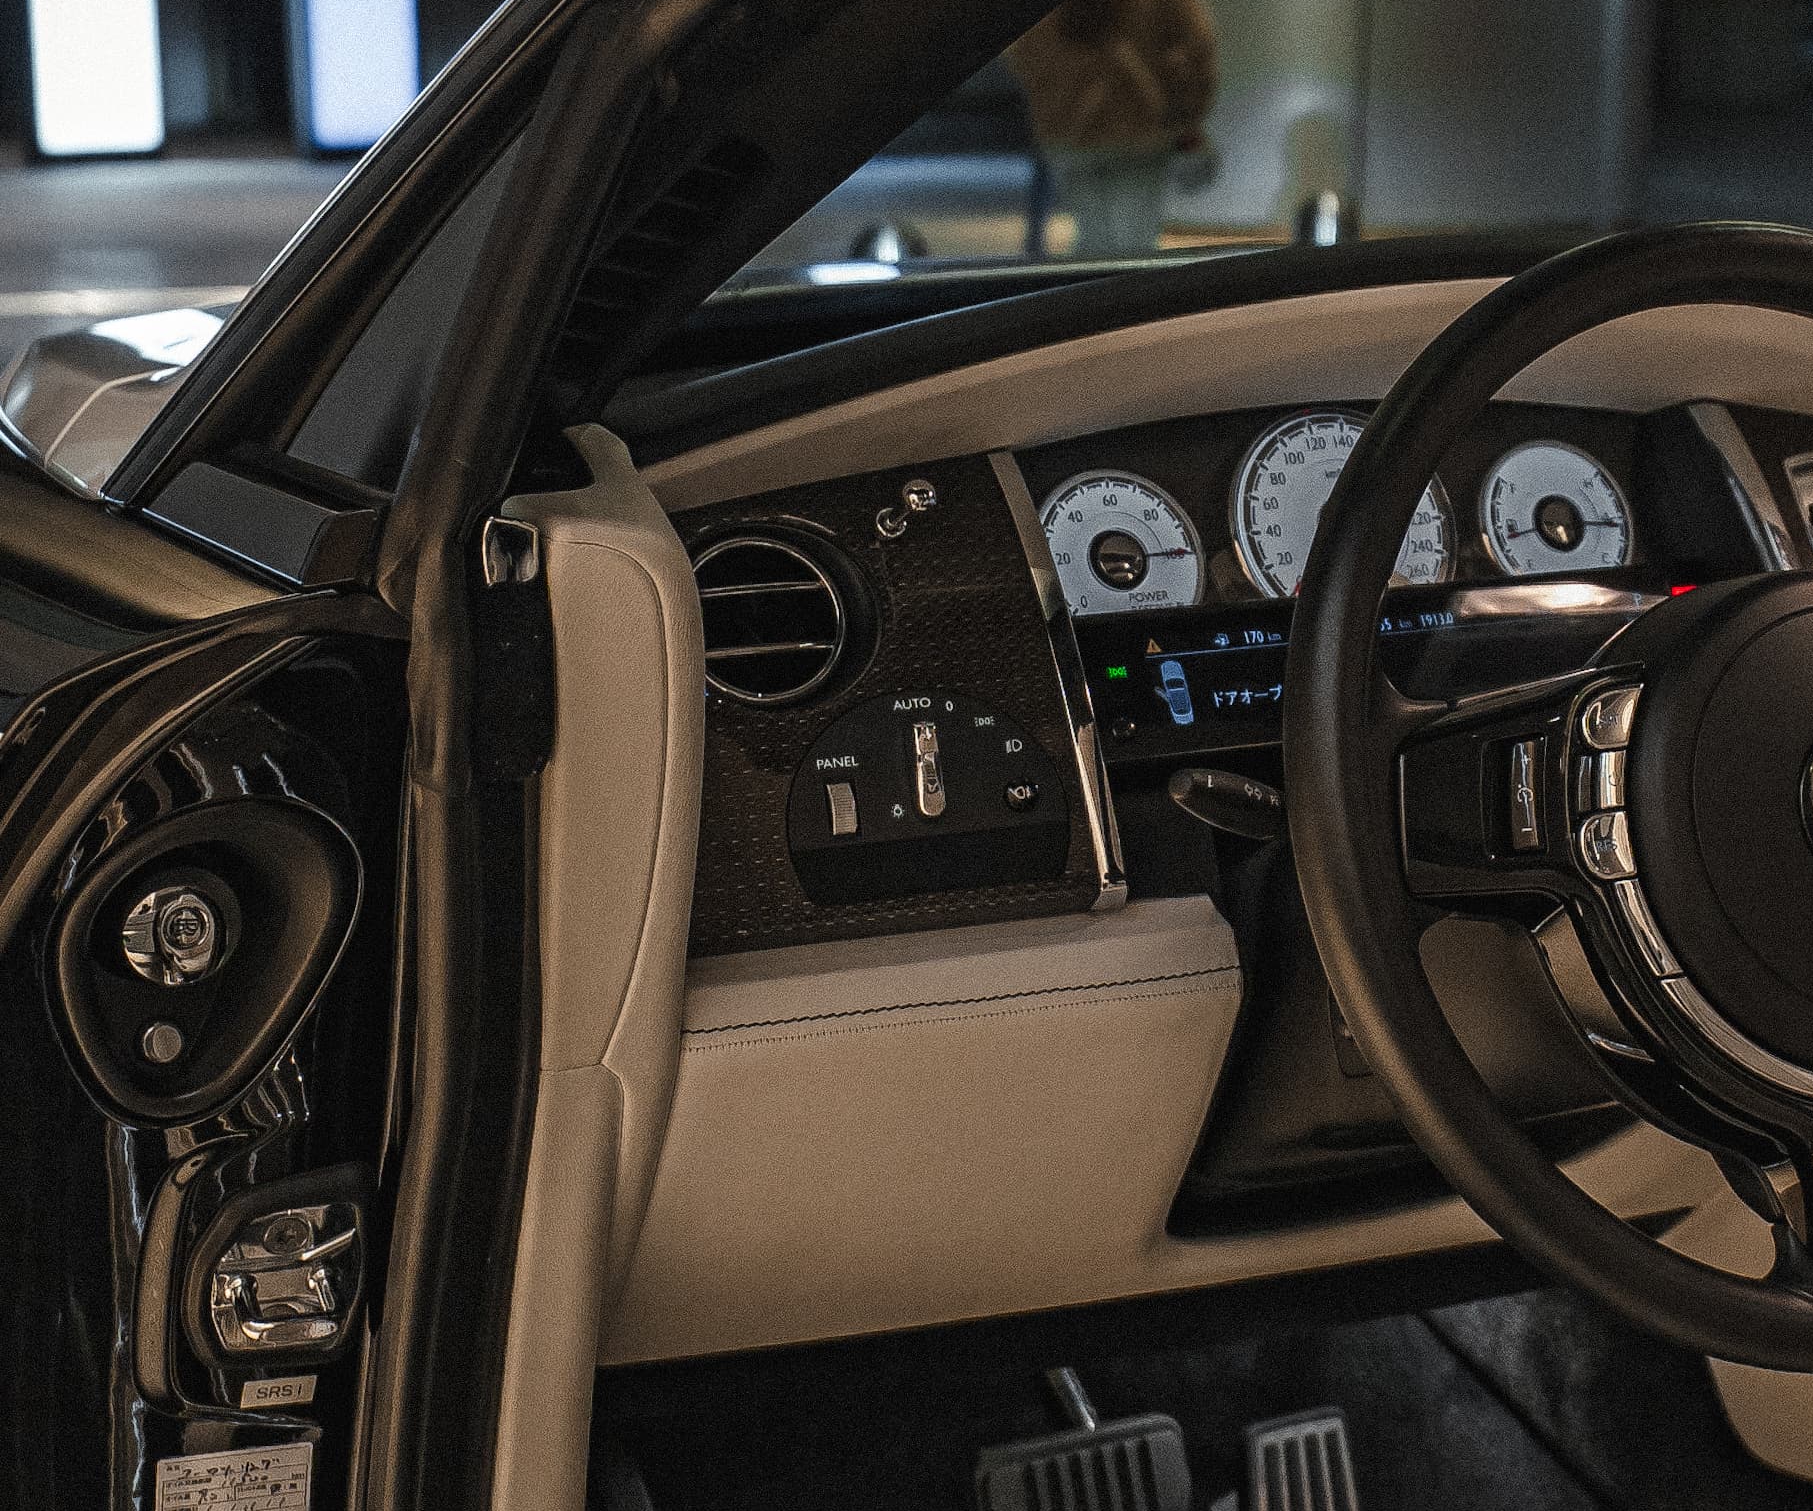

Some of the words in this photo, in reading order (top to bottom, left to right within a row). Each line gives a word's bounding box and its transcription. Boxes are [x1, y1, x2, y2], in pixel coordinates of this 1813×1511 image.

[1305, 436, 1327, 451] 120
[1333, 434, 1354, 449] 140
[1283, 451, 1305, 466] 100
[1269, 472, 1287, 486] 80
[1102, 493, 1118, 507] 60
[1262, 496, 1279, 510] 60
[1067, 509, 1084, 523] 40
[1143, 509, 1159, 522] 80
[1265, 524, 1282, 538] 40
[1410, 539, 1433, 554] 240
[1055, 552, 1071, 566] 20
[1277, 551, 1293, 566] 20
[1080, 595, 1088, 608] 0
[1128, 590, 1170, 603] POWER
[1243, 630, 1264, 644] 170
[893, 697, 931, 711] AUTO
[816, 755, 859, 770] PANEL
[256, 1384, 293, 1400] SRS
